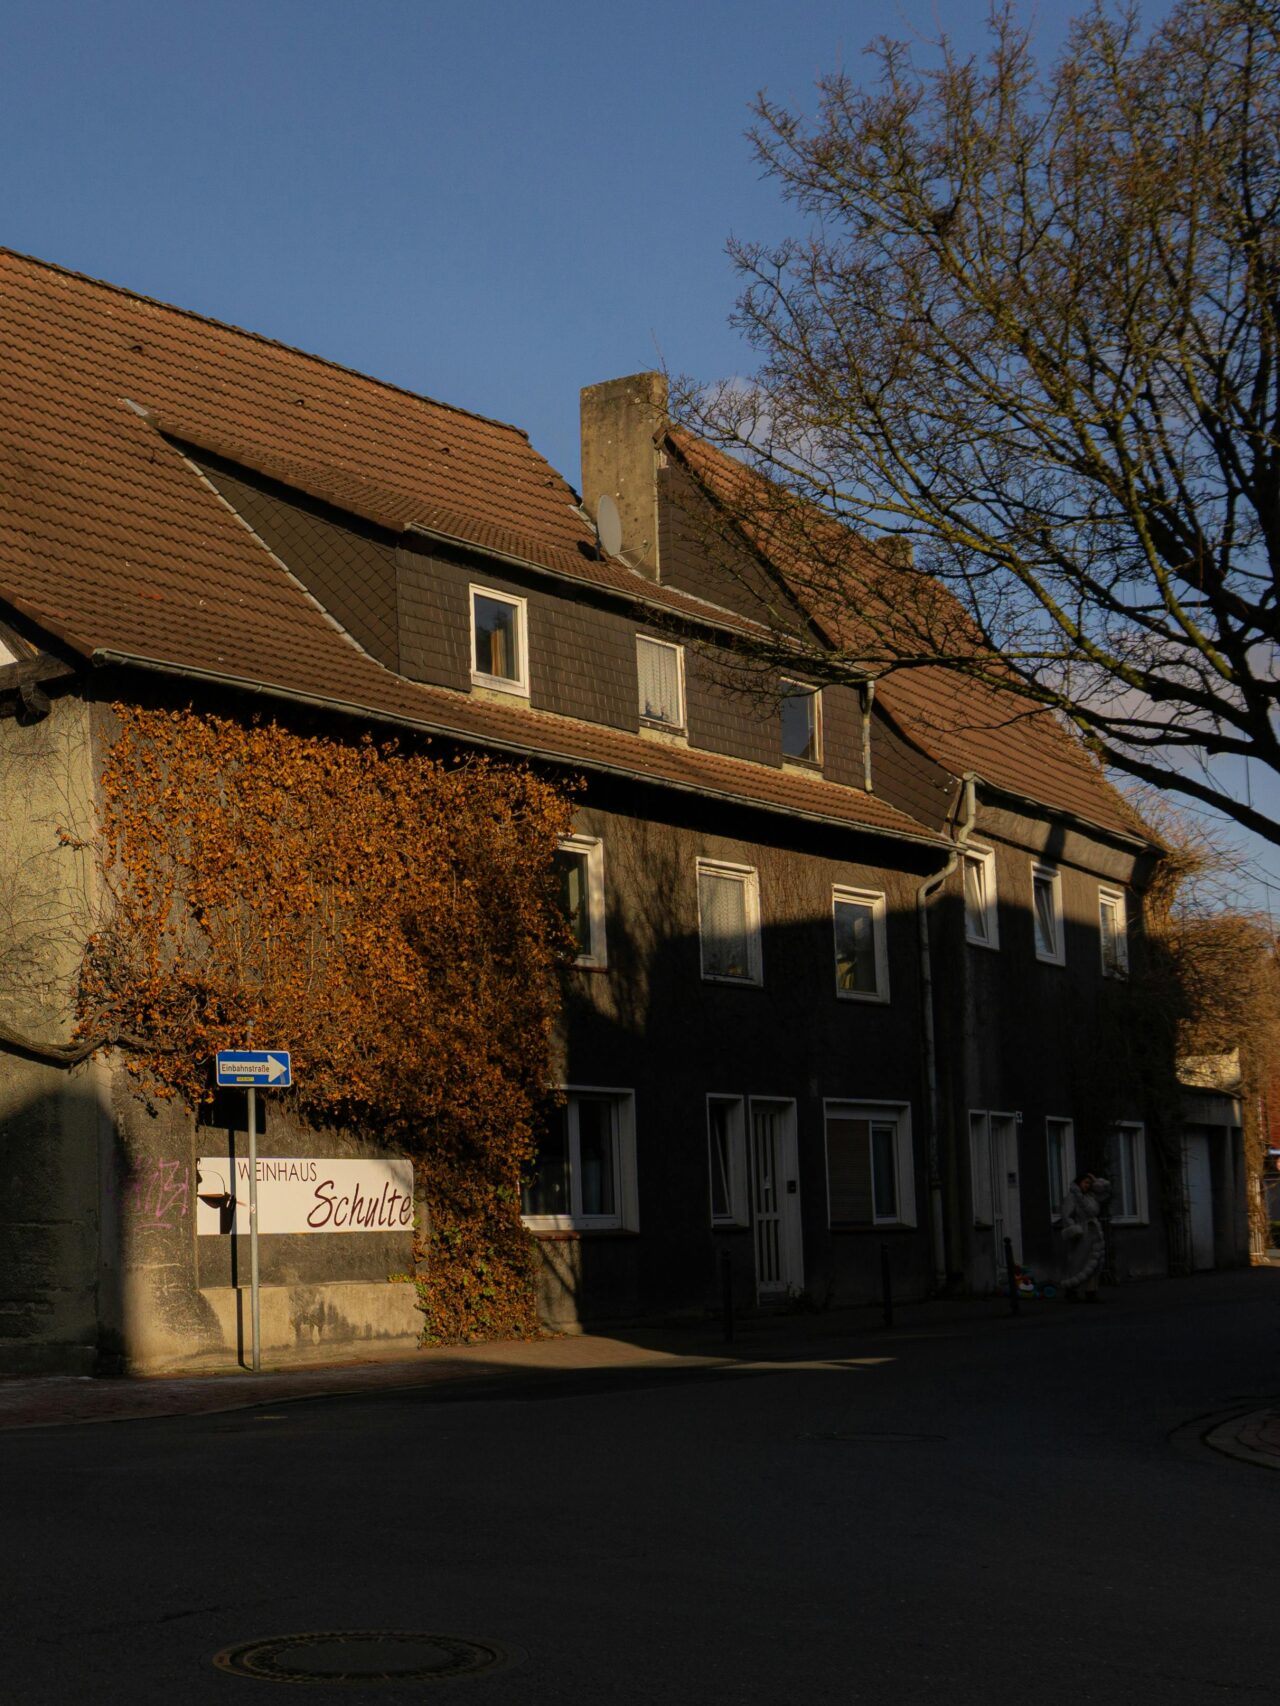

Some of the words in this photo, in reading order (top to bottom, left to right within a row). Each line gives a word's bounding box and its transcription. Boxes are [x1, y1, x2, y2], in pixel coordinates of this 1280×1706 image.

[221, 1063, 270, 1073] Einbahnstraße
[237, 1161, 318, 1182] WEINHAUS
[306, 1179, 412, 1229] Schulte
